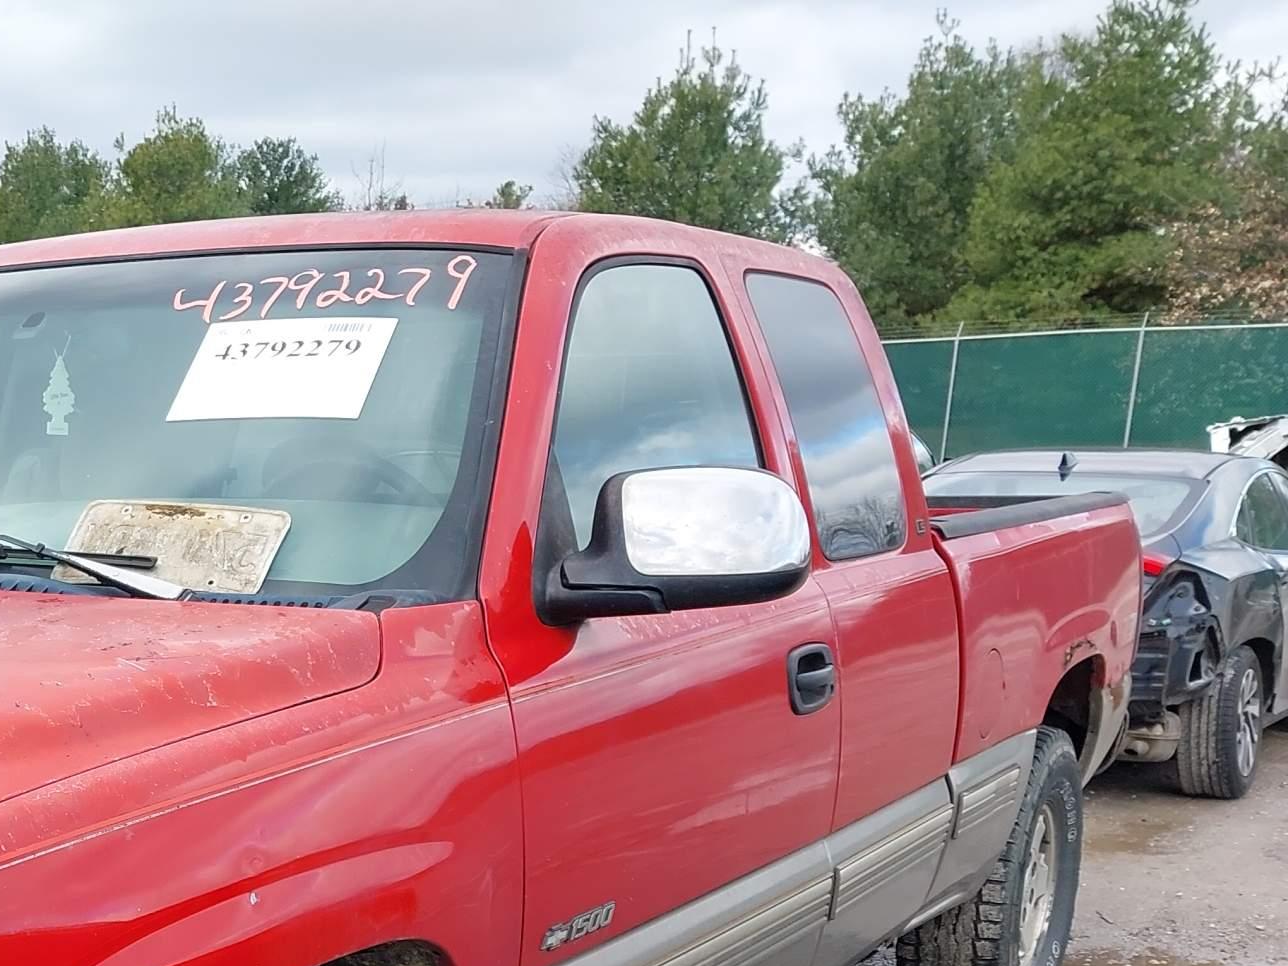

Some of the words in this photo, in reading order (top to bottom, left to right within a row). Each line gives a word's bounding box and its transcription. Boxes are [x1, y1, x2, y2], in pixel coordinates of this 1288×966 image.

[172, 254, 477, 324] 43792279
[214, 338, 363, 361] 43792279
[569, 902, 617, 942] 1500
